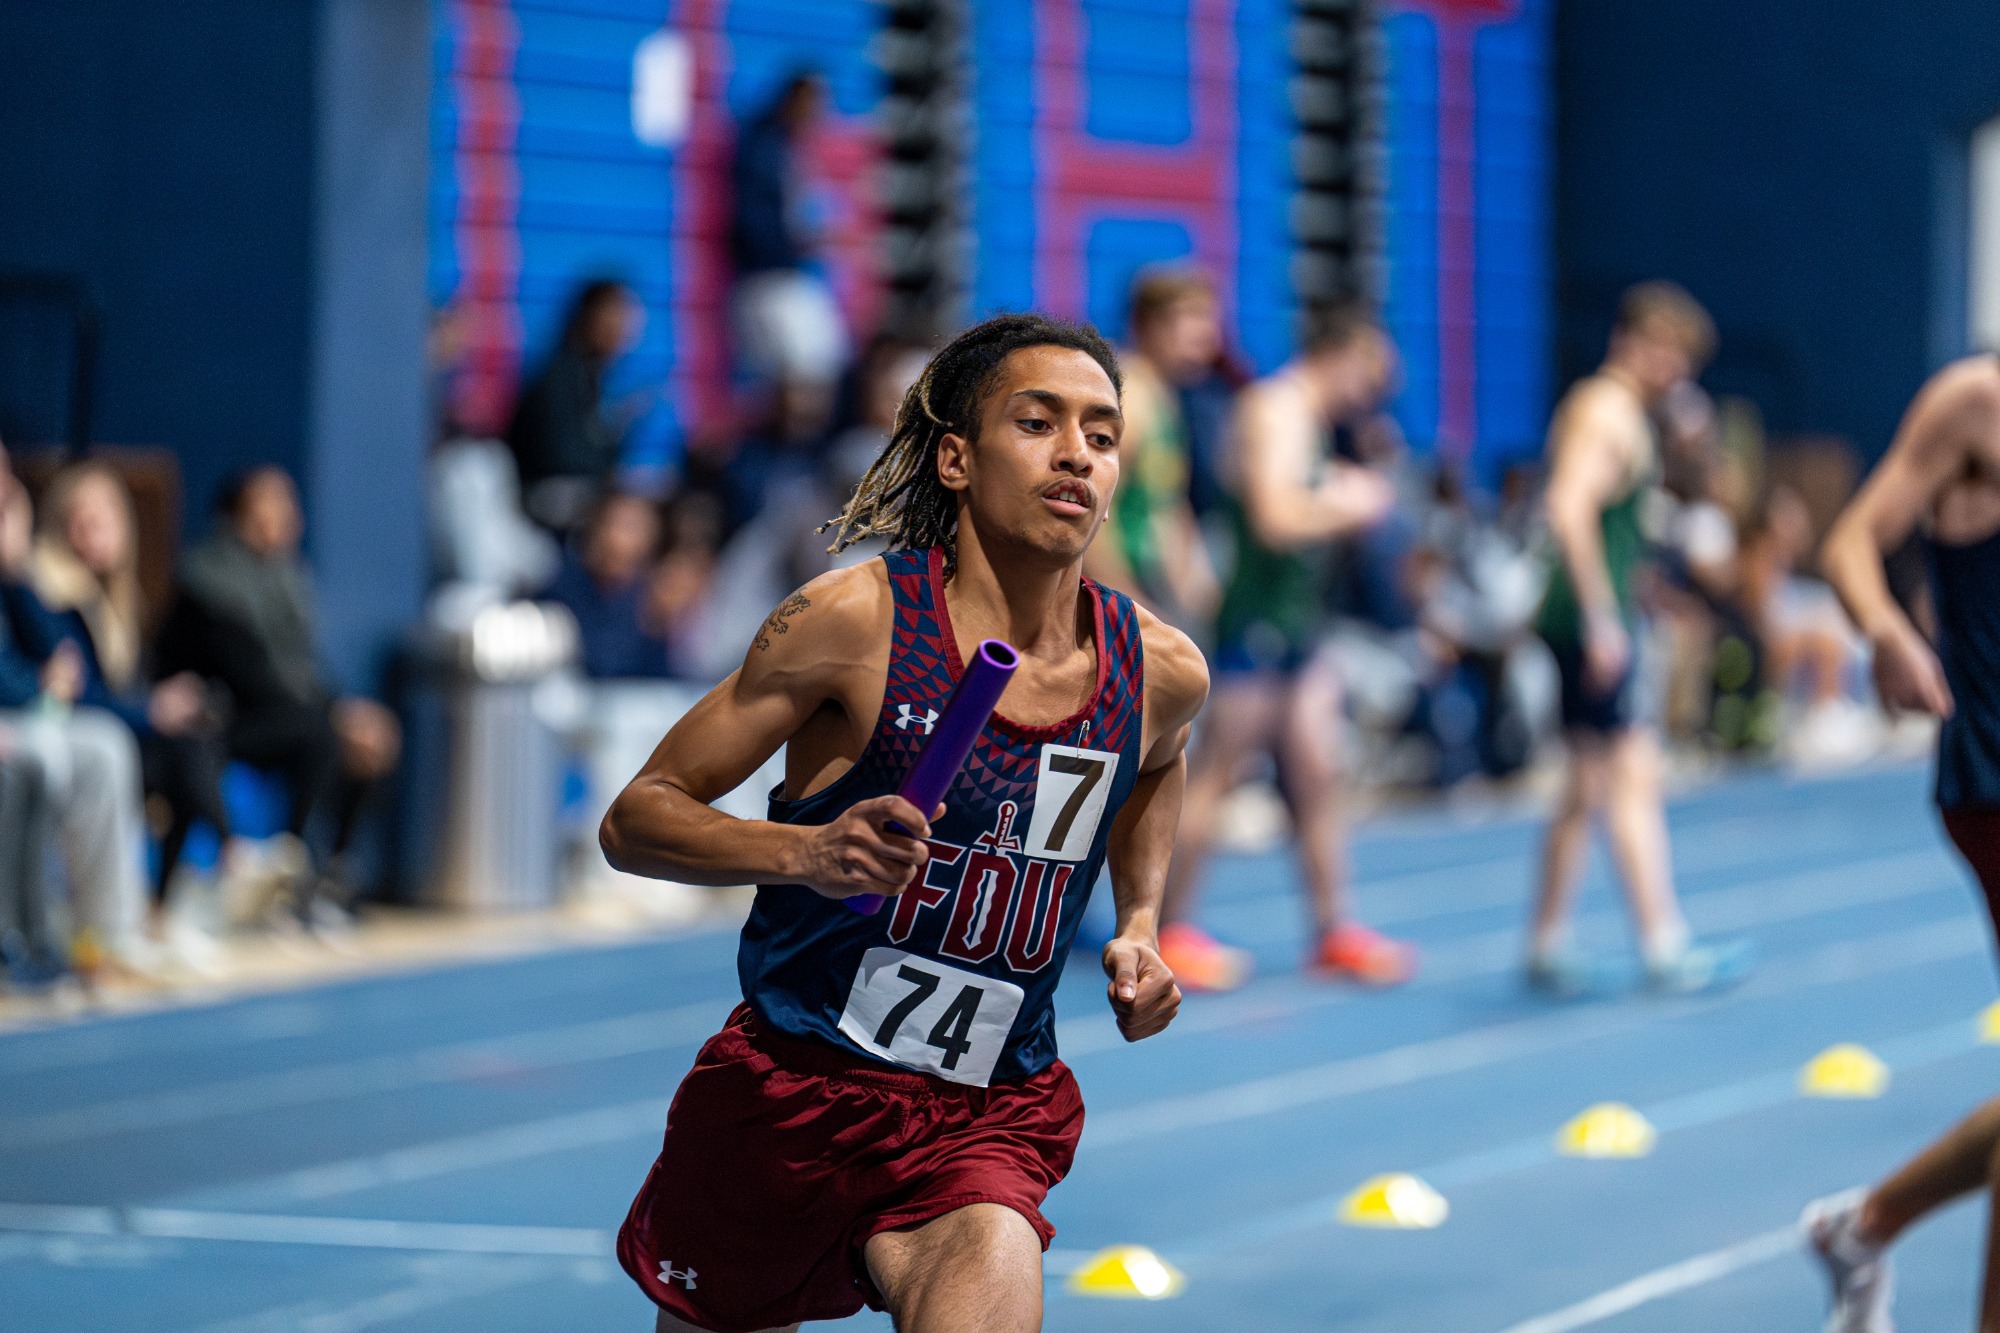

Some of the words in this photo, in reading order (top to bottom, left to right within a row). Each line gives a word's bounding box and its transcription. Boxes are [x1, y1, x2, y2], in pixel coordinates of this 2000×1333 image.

[1044, 753, 1106, 852] 7
[887, 838, 1075, 973] FDU
[873, 963, 985, 1071] 74
